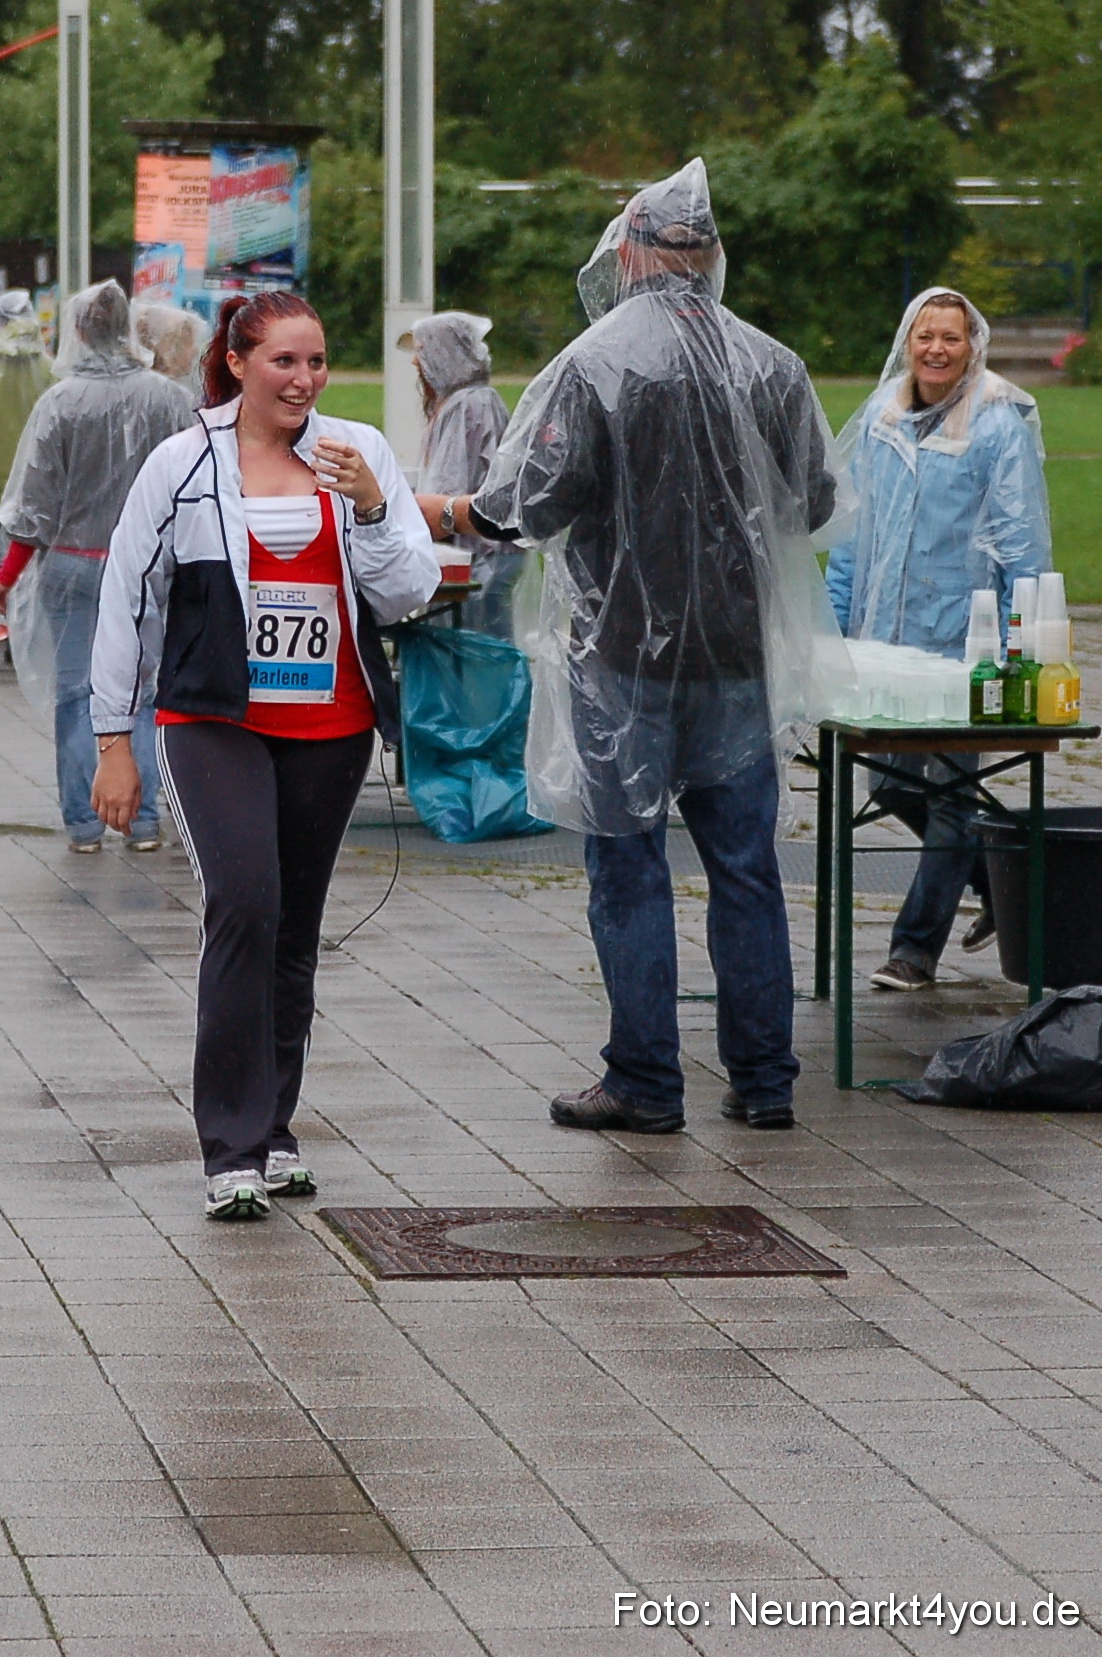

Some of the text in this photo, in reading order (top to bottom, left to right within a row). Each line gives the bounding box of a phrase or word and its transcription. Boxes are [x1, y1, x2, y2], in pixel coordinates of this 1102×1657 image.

[256, 590, 306, 602] BOCK
[247, 614, 329, 659] 878
[249, 667, 309, 686] Marlene
